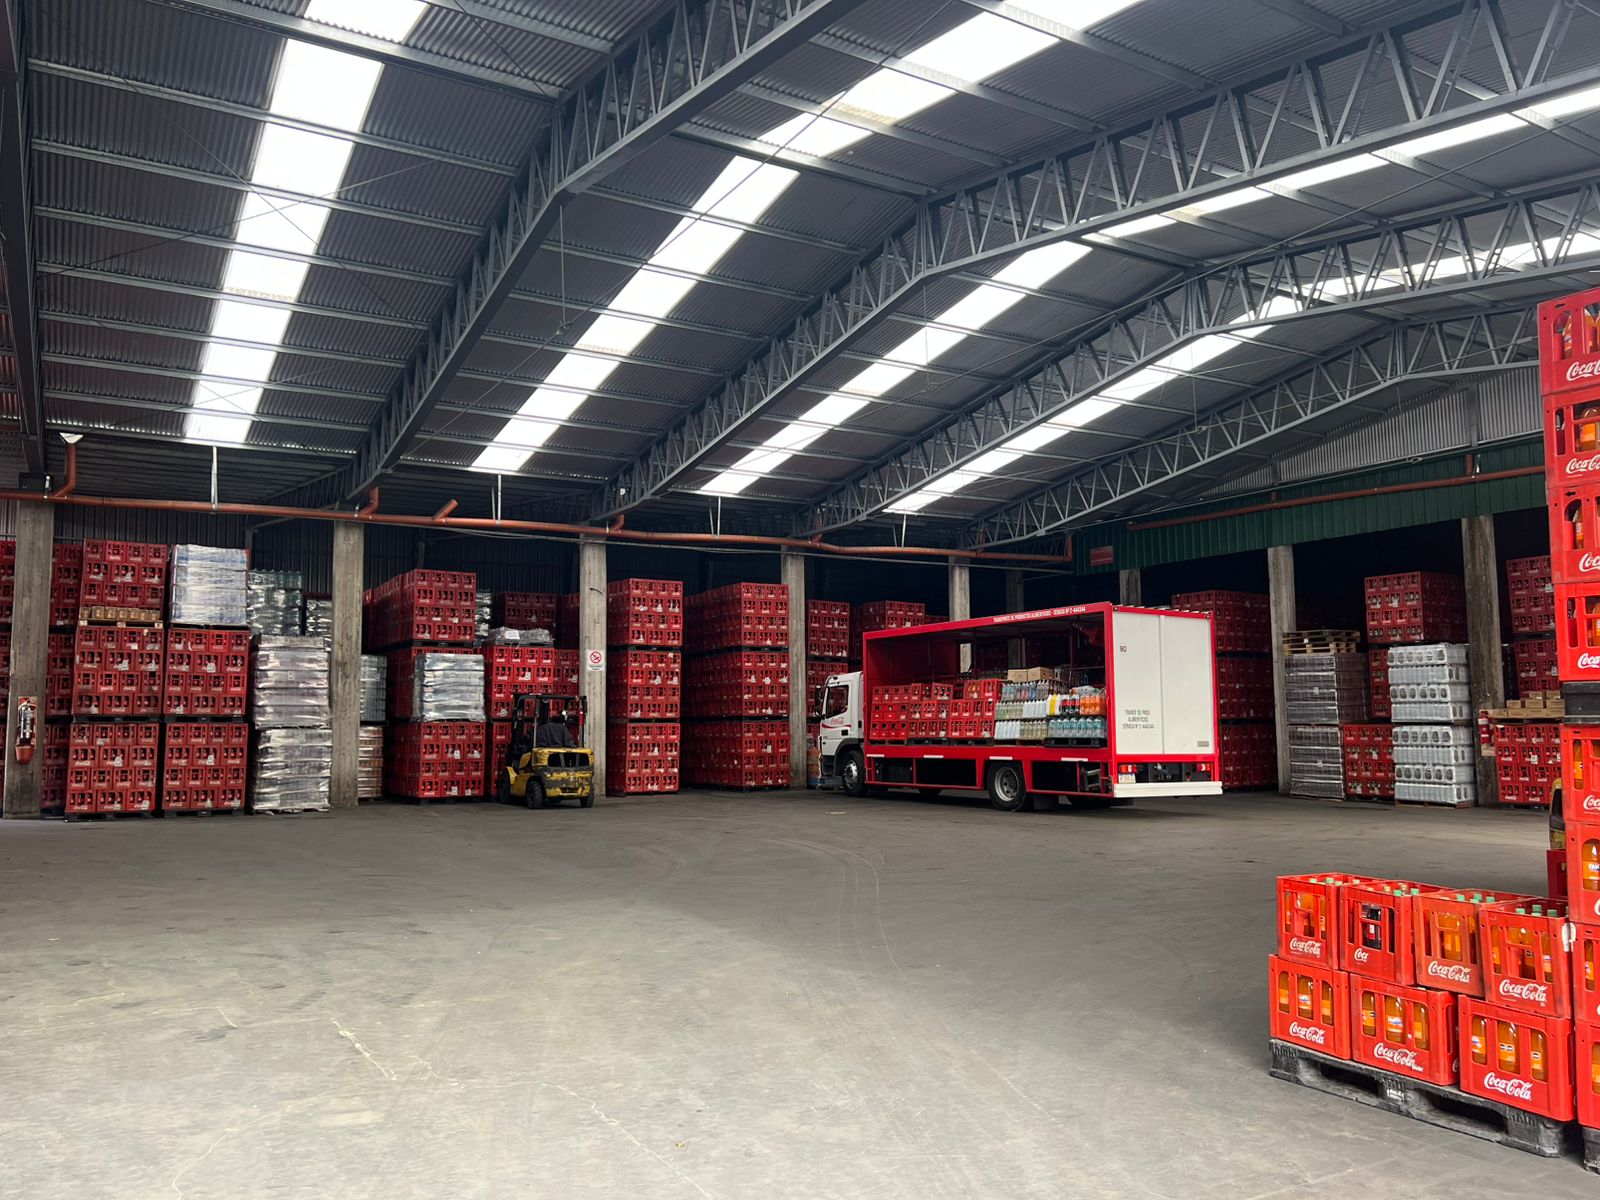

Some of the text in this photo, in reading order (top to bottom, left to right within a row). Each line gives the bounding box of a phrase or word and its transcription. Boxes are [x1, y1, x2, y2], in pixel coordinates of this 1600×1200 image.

[1290, 938, 1321, 958] Coca-Cola
[1428, 961, 1471, 982] Coca-Cola
[1500, 980, 1548, 1002] Coca-Cola
[1290, 1022, 1325, 1044] Coca-Cola
[1374, 1043, 1417, 1067] Coca-Cola
[1484, 1072, 1532, 1100] Coca-Cola
